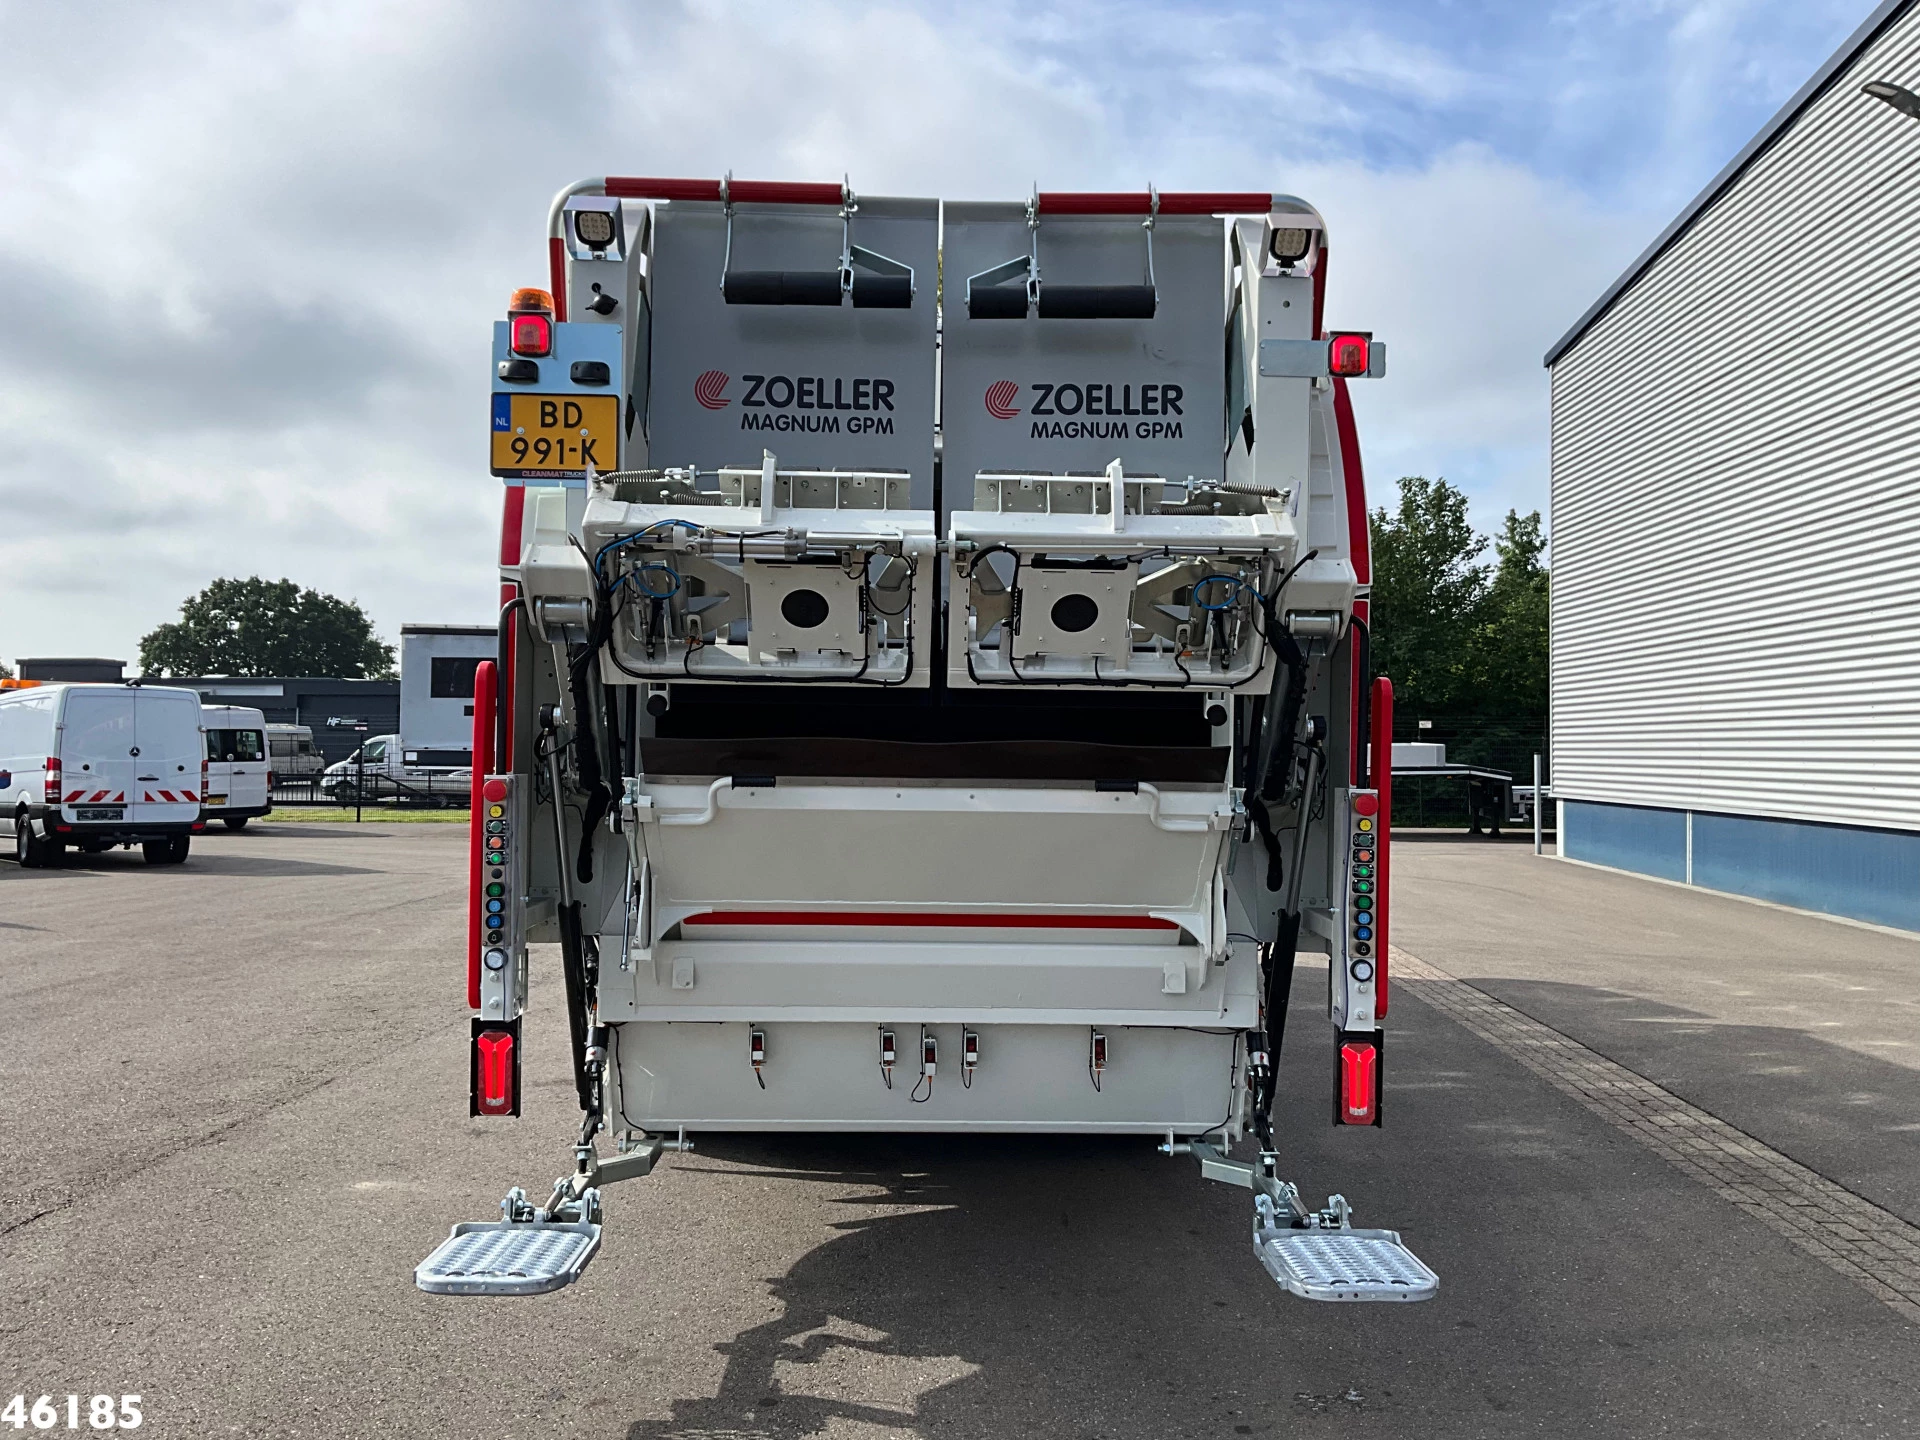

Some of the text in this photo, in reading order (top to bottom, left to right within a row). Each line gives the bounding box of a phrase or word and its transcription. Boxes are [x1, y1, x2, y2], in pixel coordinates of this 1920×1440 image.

[741, 375, 895, 411] ZOELLER
[1030, 383, 1184, 416] ZOELLER
[495, 417, 509, 426] NL
[540, 400, 583, 428] BD
[740, 412, 895, 435] MAGNUM GPM
[1030, 421, 1183, 439] MAGNUM GPM
[510, 436, 600, 466] 991-K
